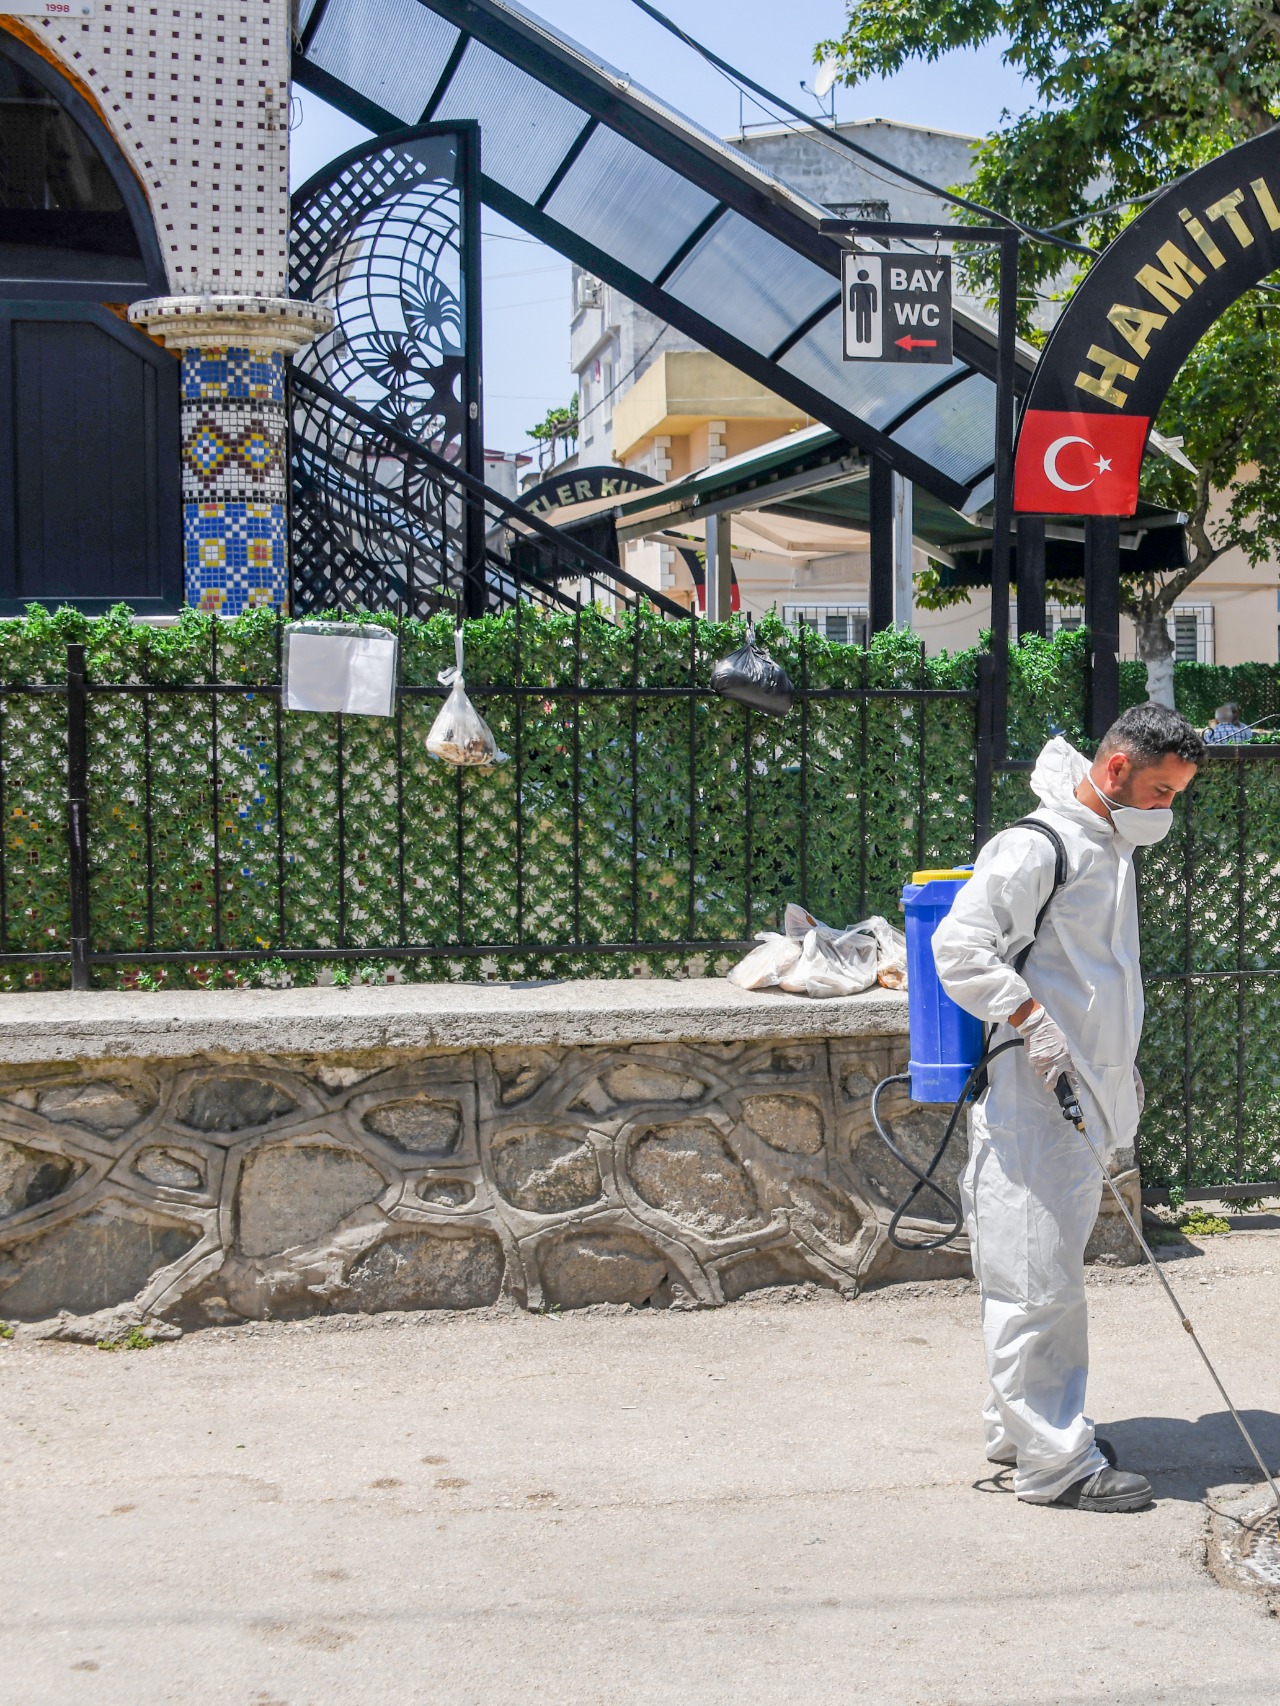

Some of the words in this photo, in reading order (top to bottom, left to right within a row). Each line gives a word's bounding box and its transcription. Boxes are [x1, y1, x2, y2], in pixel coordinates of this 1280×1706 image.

[46, 3, 70, 13] 1998
[890, 267, 945, 293] BAY
[893, 302, 940, 327] WC
